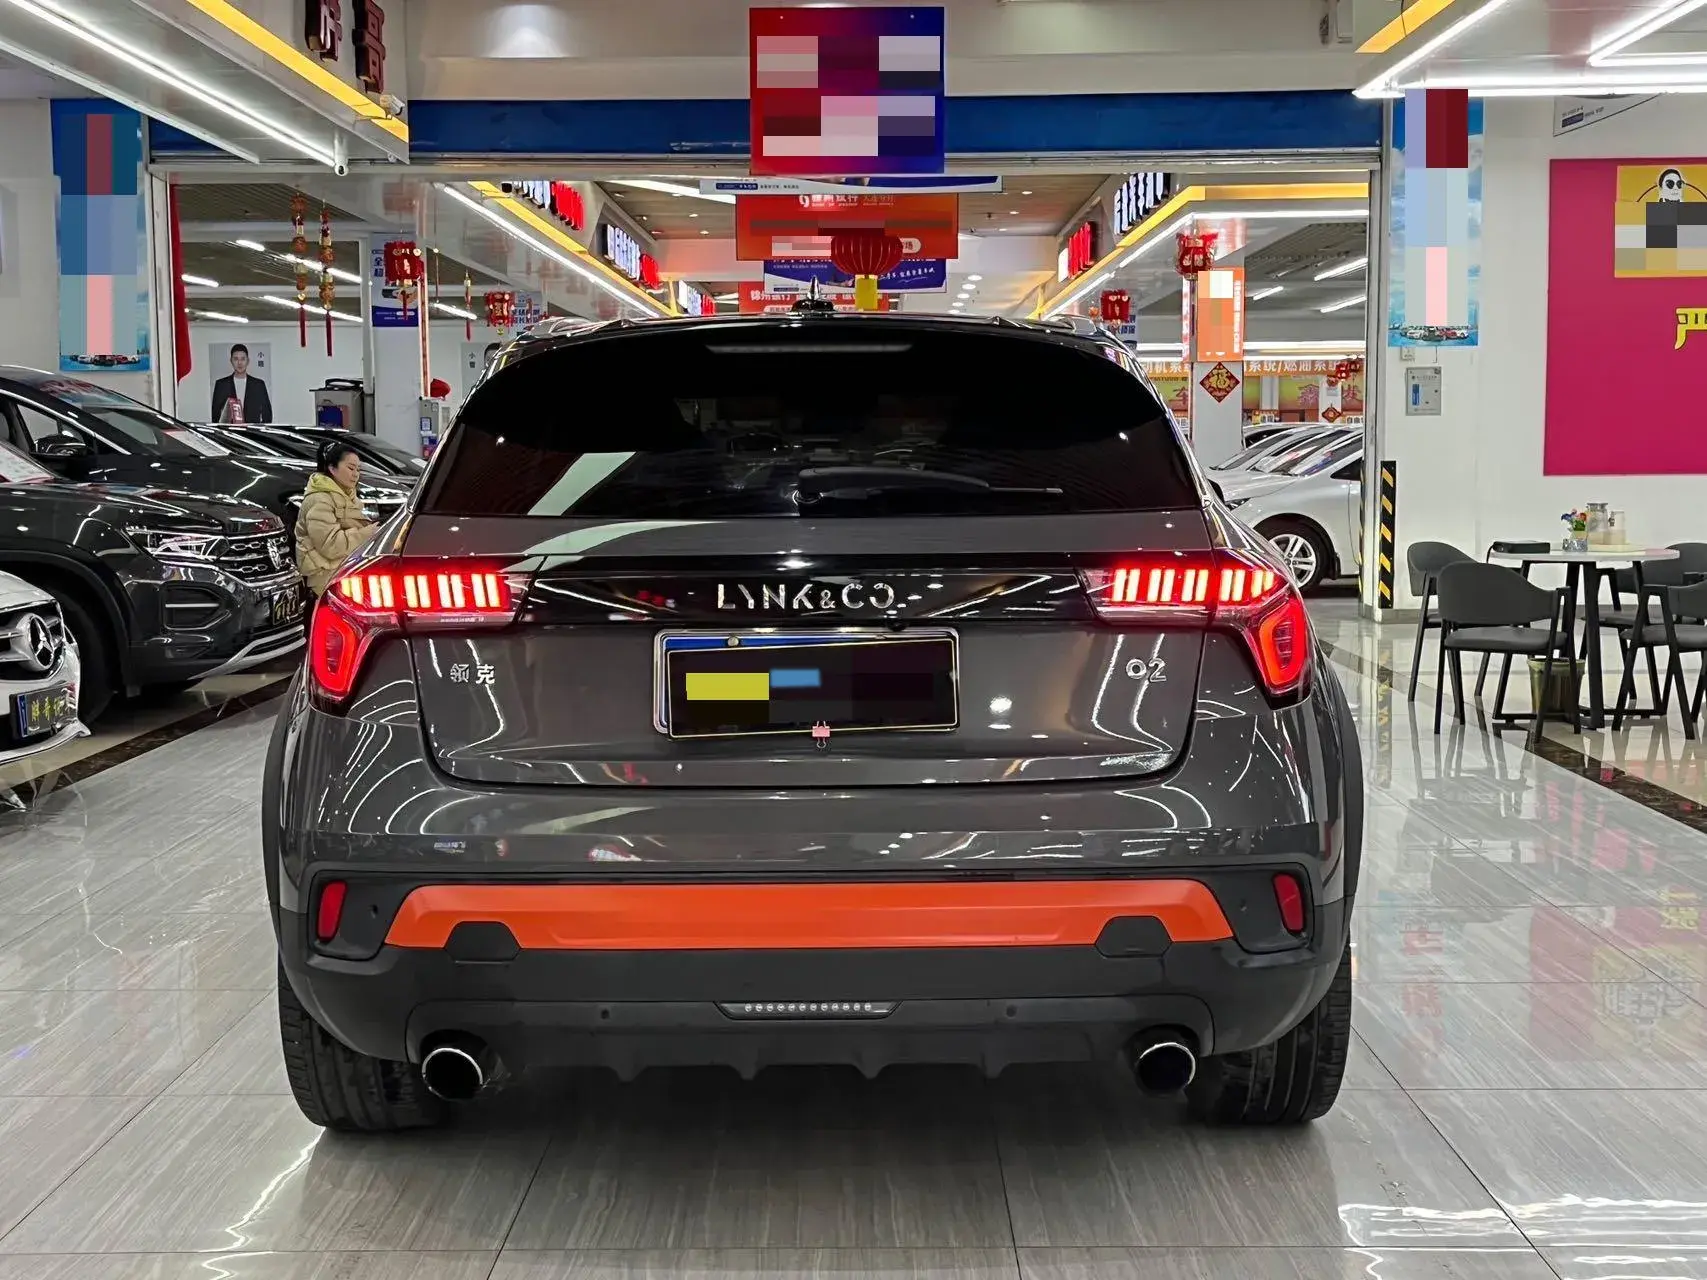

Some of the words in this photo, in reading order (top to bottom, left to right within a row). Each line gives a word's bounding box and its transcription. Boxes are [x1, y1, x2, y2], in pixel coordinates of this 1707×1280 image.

[1209, 367, 1231, 390] 福
[717, 582, 895, 610] LYNK&CO
[450, 663, 496, 684] 领克
